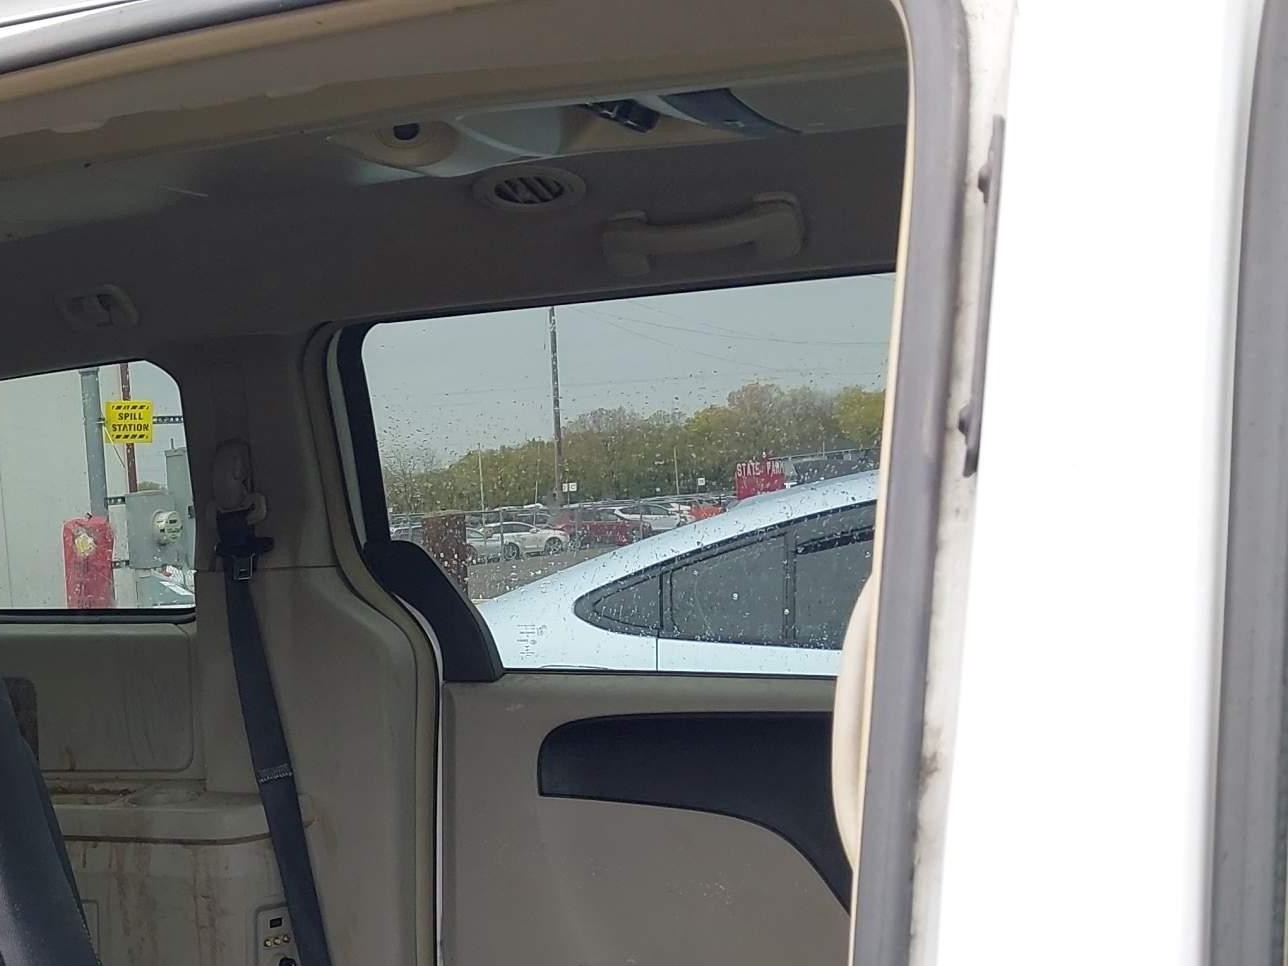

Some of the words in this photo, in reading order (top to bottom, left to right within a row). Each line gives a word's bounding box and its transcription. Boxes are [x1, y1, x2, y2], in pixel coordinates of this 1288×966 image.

[118, 412, 143, 421] SPILL
[112, 423, 149, 432] STATION
[736, 461, 761, 477] STATE
